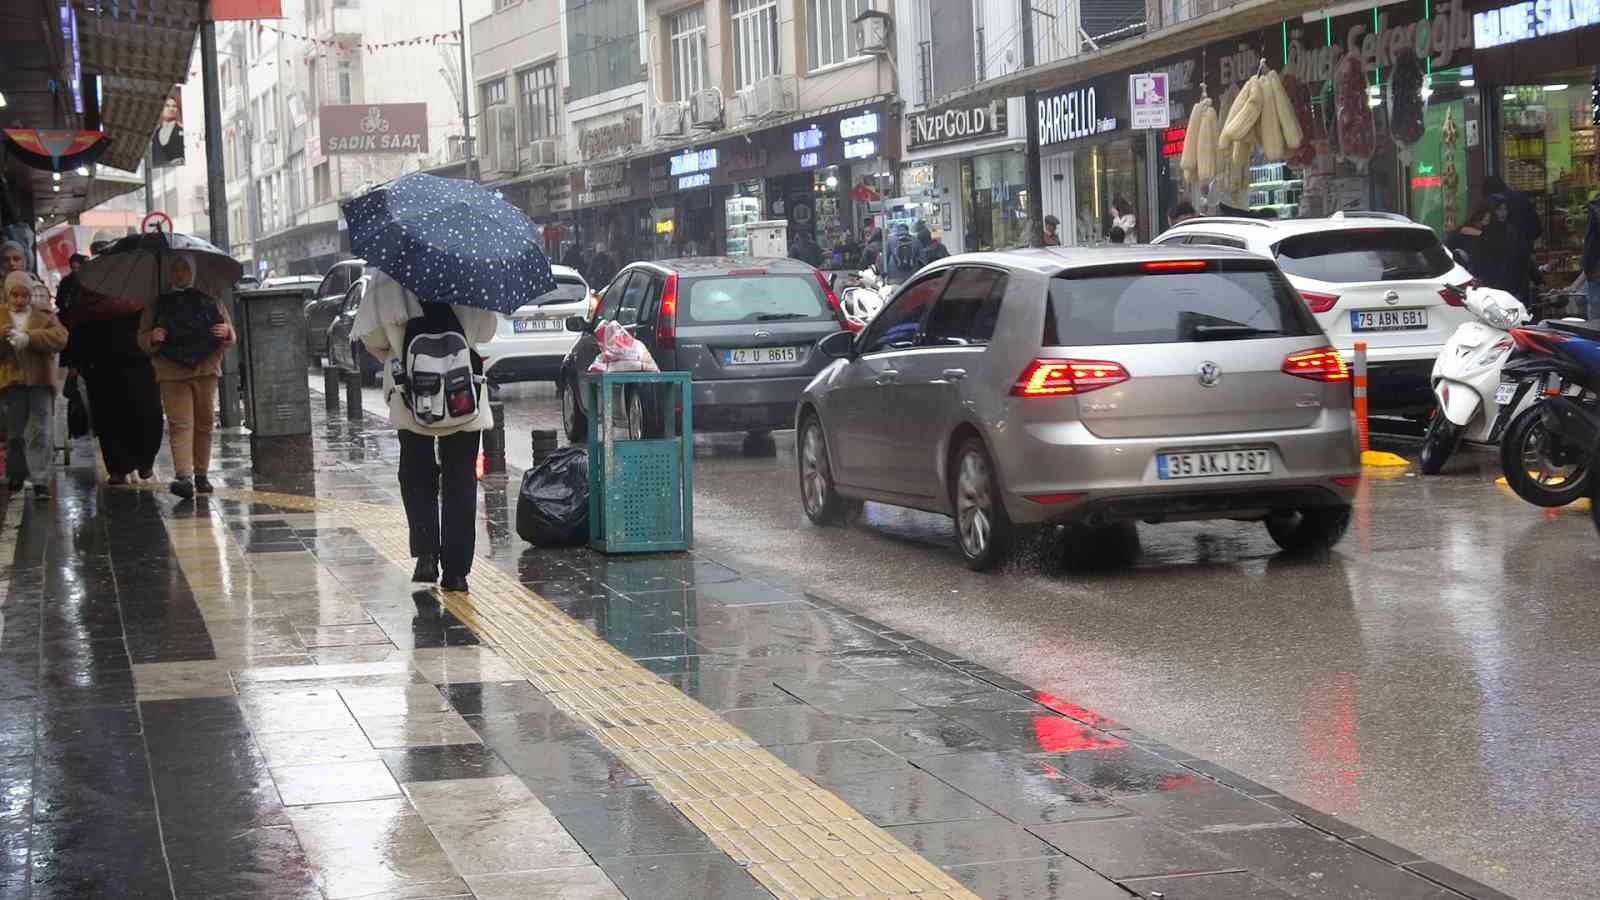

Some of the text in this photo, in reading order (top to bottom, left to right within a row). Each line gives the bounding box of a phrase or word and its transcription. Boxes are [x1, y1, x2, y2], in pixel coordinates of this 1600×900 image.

[916, 108, 985, 142] NZPGOLD
[1038, 87, 1096, 146] BARGELLO
[328, 134, 421, 150] SADIK SAAT
[1379, 312, 1399, 325] ABN
[733, 348, 794, 362] 42 U 8615
[1169, 455, 1192, 475] 35
[1199, 453, 1231, 473] AKJ
